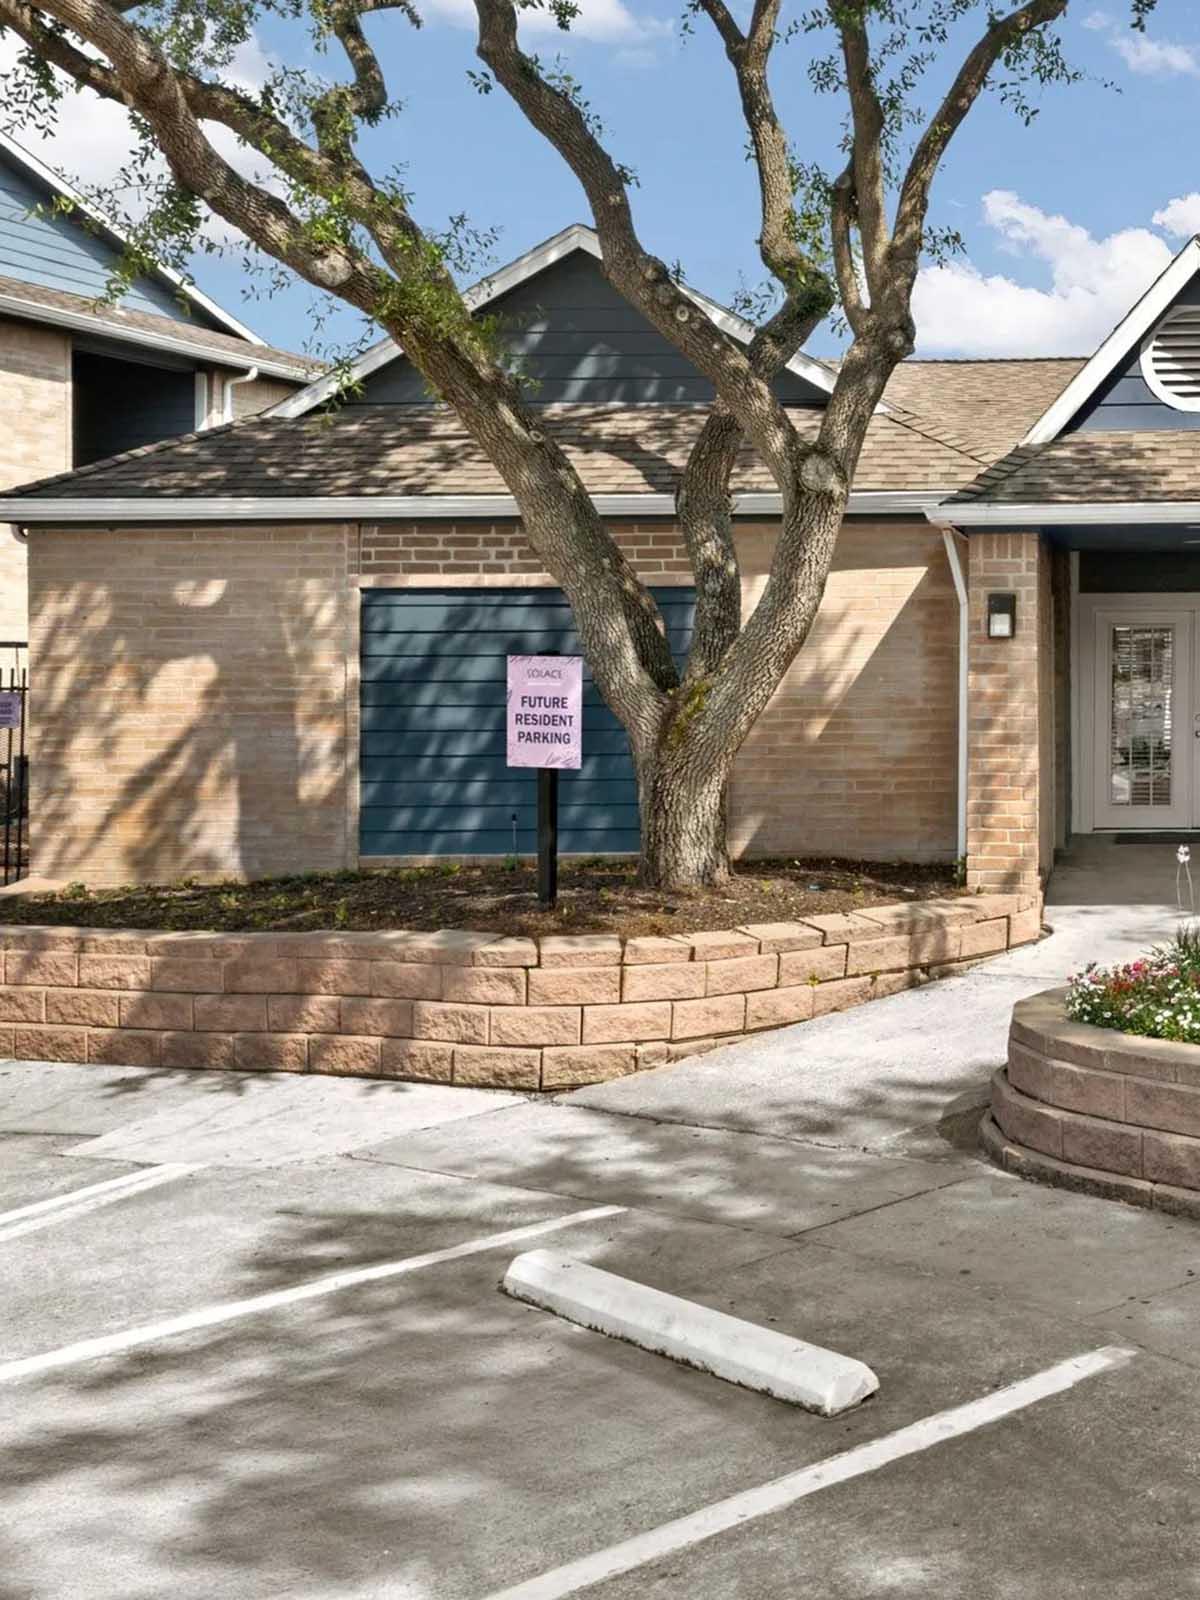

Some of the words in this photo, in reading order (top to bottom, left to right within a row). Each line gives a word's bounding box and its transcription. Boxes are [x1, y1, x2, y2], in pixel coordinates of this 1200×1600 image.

[520, 695, 569, 709] FUTURE
[514, 713, 574, 727] RESIDENT
[517, 731, 571, 744] PARKING
